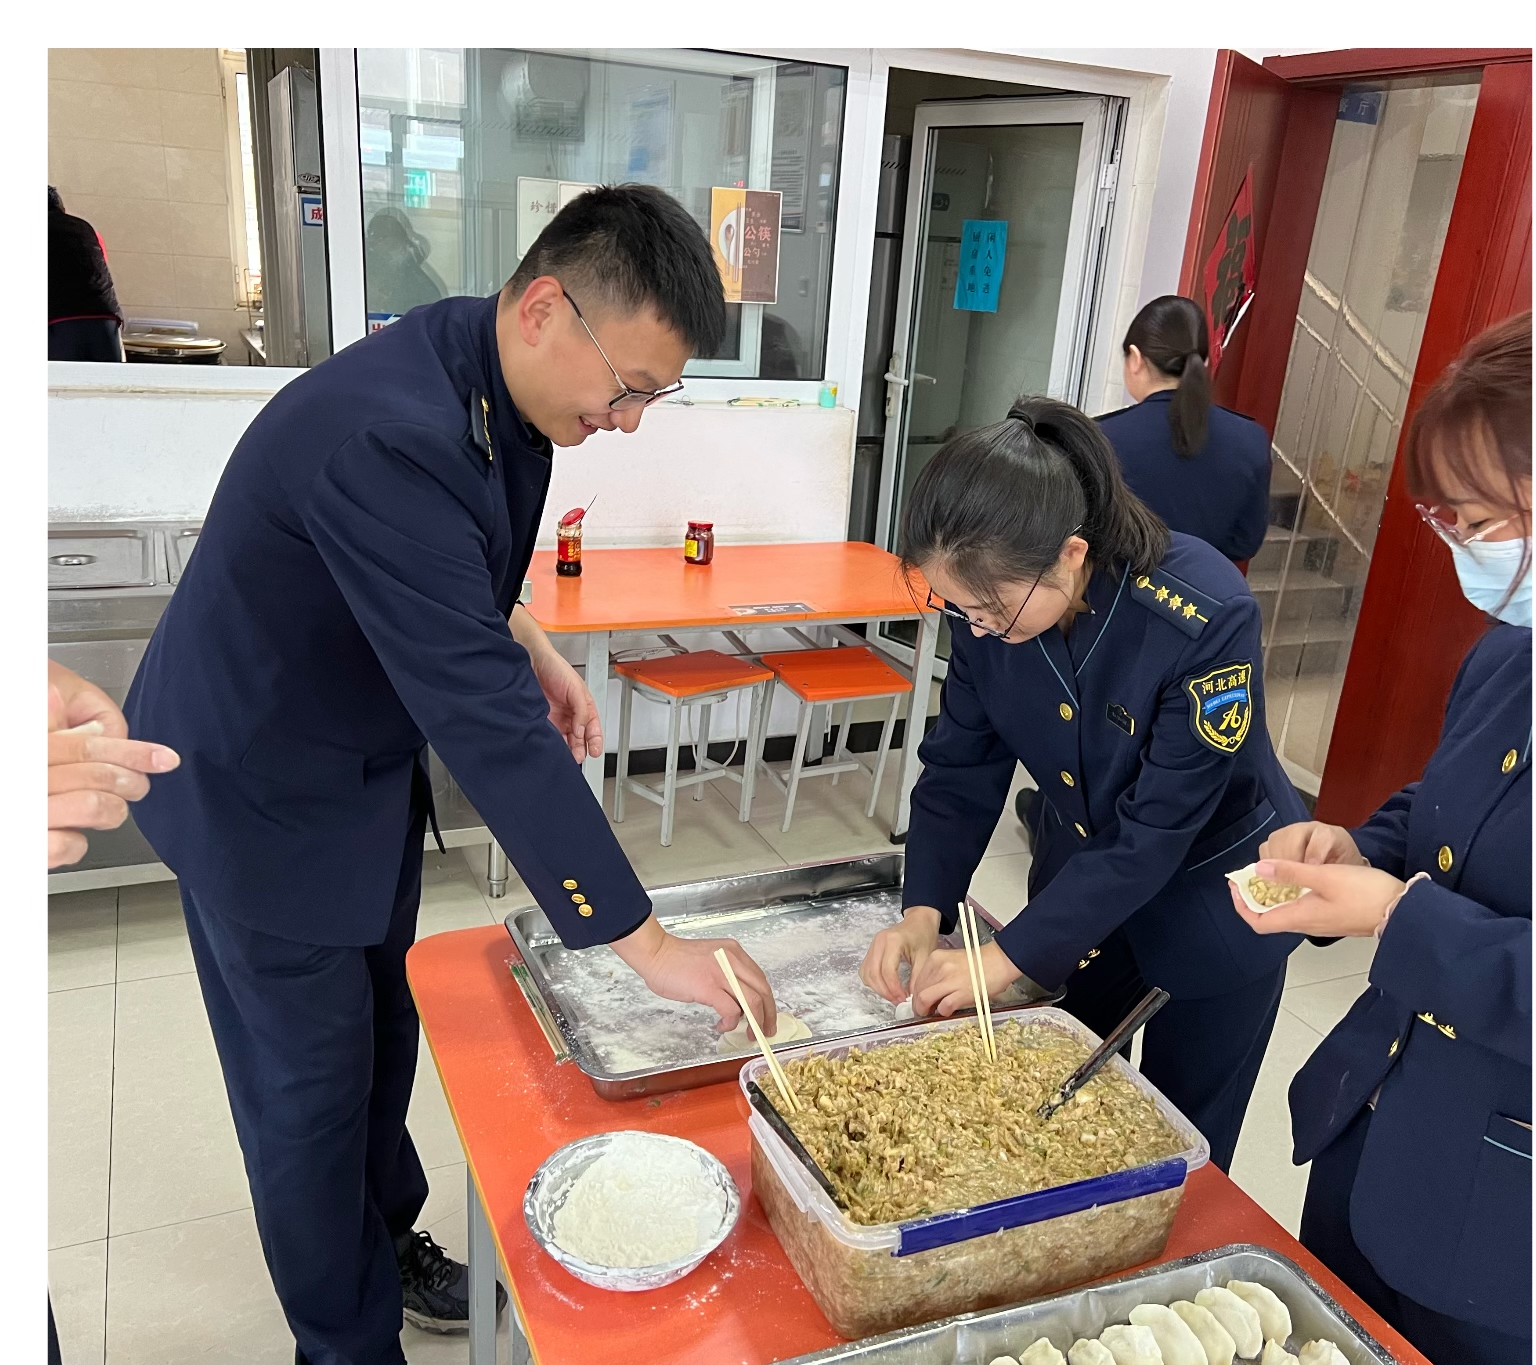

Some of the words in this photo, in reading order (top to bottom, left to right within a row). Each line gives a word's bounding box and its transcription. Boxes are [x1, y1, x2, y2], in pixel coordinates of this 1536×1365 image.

[744, 225, 772, 241] 公筷
[743, 247, 761, 257] 公勺
[1202, 670, 1246, 695] 河北高速
